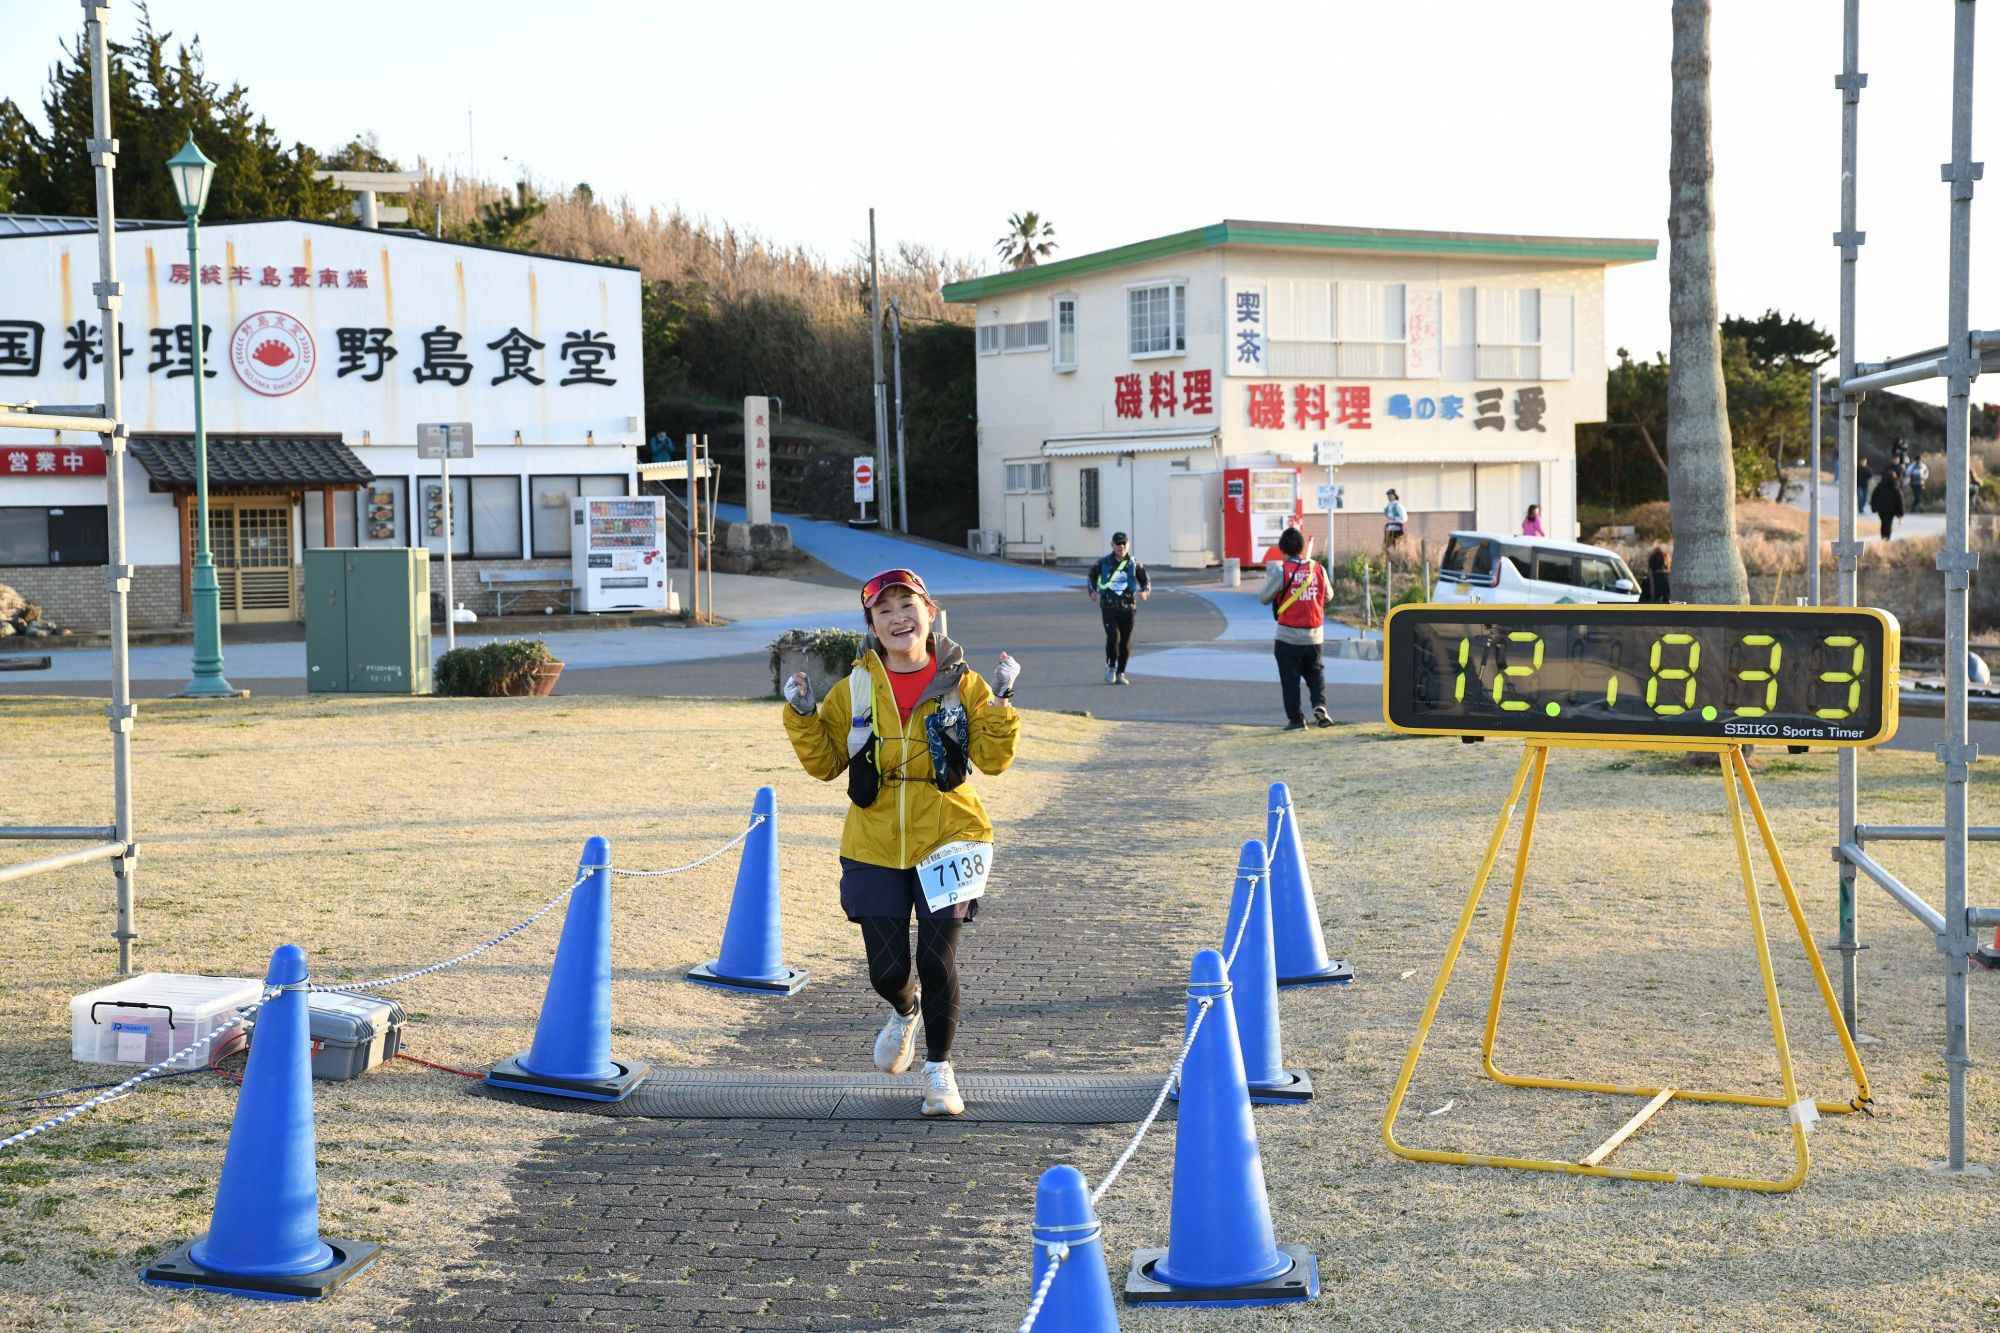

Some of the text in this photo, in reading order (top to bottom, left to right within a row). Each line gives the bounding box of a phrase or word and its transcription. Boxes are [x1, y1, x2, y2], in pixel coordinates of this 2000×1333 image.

[168, 263, 368, 288] 房総半島最南端
[1236, 290, 1260, 364] 喫茶
[336, 325, 617, 387] 野島食堂
[1115, 369, 1212, 418] 磯料理
[1247, 383, 1372, 431] 磯料理
[1388, 393, 1463, 420] 亀の家
[1474, 386, 1546, 432] 三愛
[8, 451, 84, 472] 営業中
[1724, 723, 1865, 738] SEIKO Sports Timer
[933, 853, 985, 887] 7138
